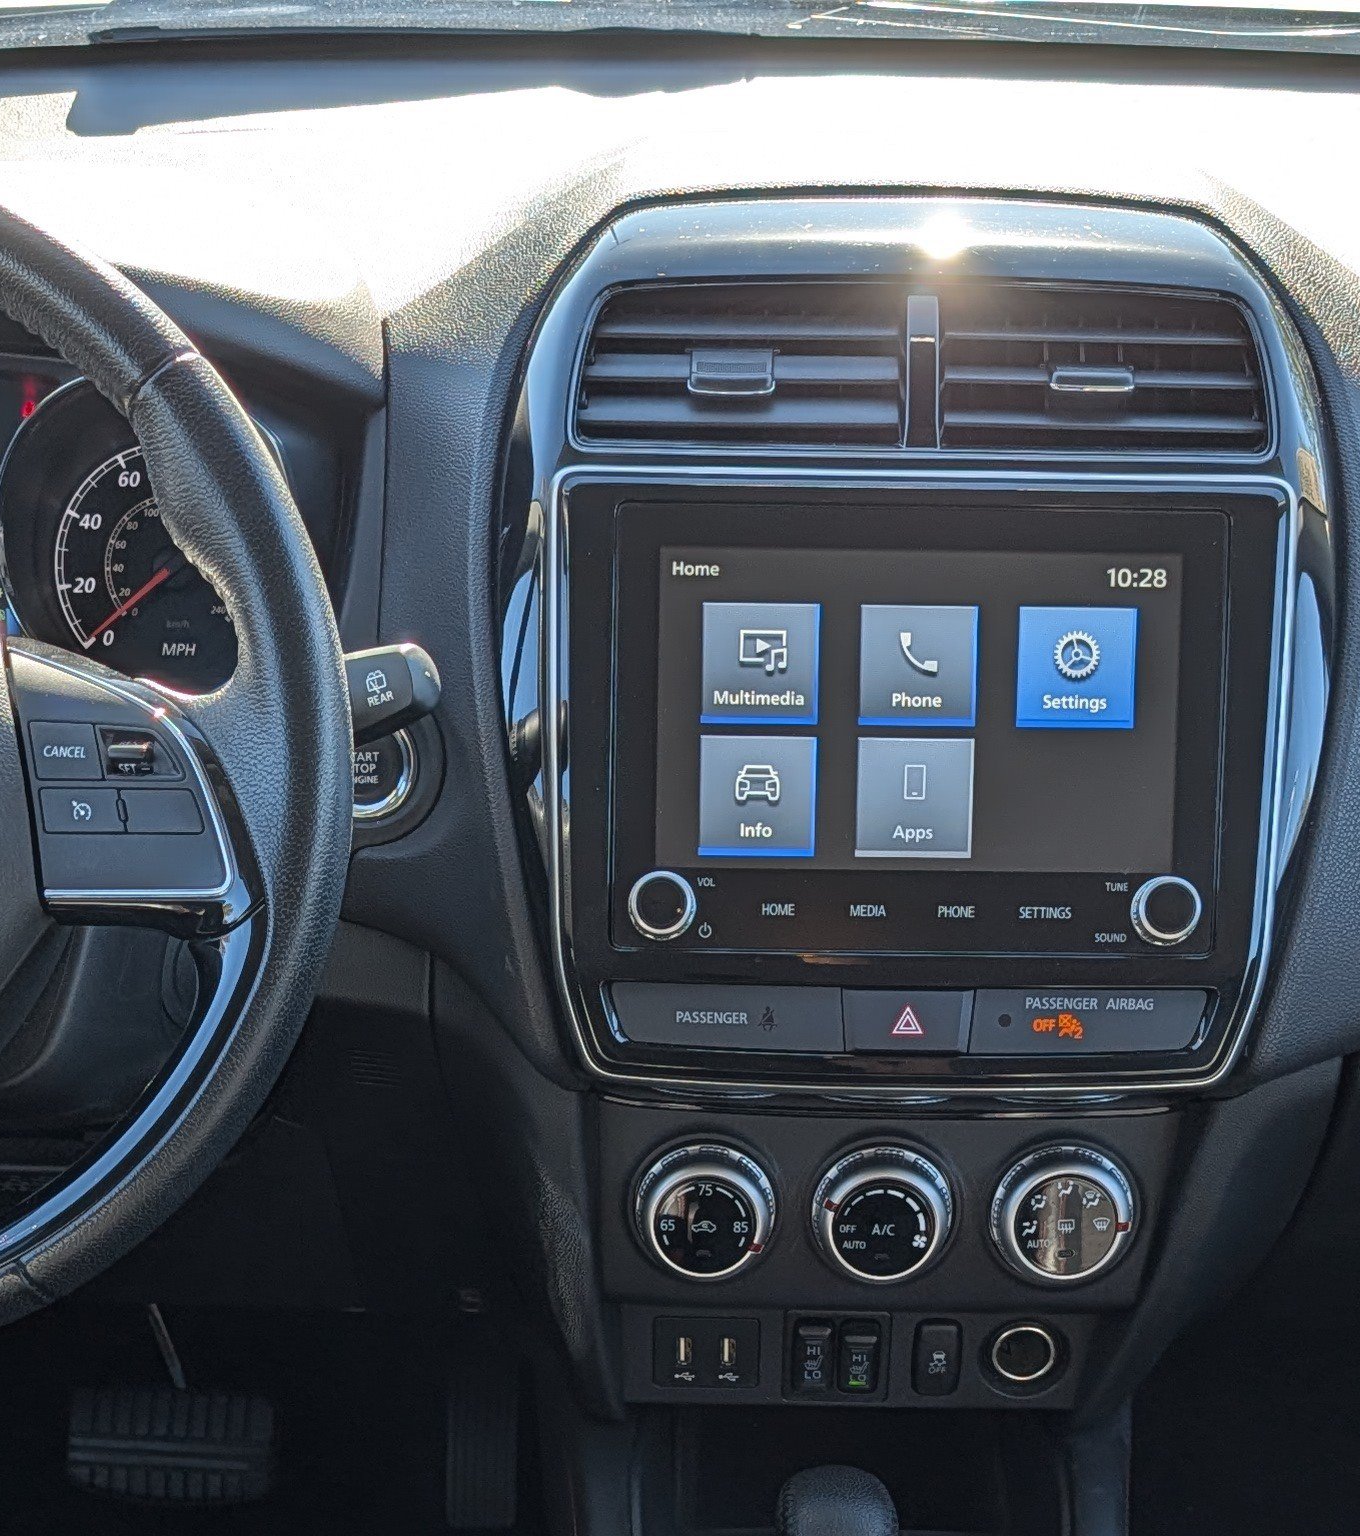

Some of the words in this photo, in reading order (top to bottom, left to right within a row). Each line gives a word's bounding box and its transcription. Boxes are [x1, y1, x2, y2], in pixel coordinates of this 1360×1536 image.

[118, 471, 141, 488] 60
[144, 508, 159, 517] 100
[79, 514, 102, 531] 40
[126, 521, 138, 530] 80
[115, 541, 127, 549] 60
[113, 564, 124, 573] 40
[672, 561, 720, 577] Home
[1106, 568, 1167, 588] 10:28
[73, 577, 96, 595] 20
[118, 588, 131, 597] 20
[103, 630, 114, 647] 0
[162, 643, 196, 656] MPH
[367, 690, 394, 707] REAR
[713, 690, 805, 706] Multimedia
[892, 692, 942, 708] Phone
[1043, 694, 1107, 713] Settings
[43, 745, 86, 759] CANCEL
[351, 751, 380, 762] TART
[353, 763, 377, 774] TOP
[739, 822, 773, 838] Info
[892, 825, 933, 843] Apps
[697, 877, 716, 887] VOL
[1105, 882, 1129, 892] TUNE
[761, 903, 796, 916] HOME
[849, 904, 887, 917] MEDIA
[937, 905, 976, 918] PHONE
[1018, 906, 1072, 919] SETTINGS
[1094, 933, 1127, 943] SOUND
[1025, 997, 1098, 1010] PASSENGER
[1106, 998, 1154, 1010] AIRBAG
[675, 1011, 748, 1026] PASSENGER
[1032, 1018, 1056, 1032] OFF
[698, 1184, 714, 1197] 75
[660, 1219, 675, 1232] 65
[733, 1220, 748, 1233] 85
[839, 1224, 857, 1233] OFF
[871, 1224, 895, 1237] A/C
[842, 1240, 866, 1250] AUTO
[1026, 1239, 1050, 1249] AUTO
[806, 1346, 821, 1356] HI
[852, 1354, 866, 1362] HI
[804, 1370, 822, 1380] LO
[928, 1366, 946, 1374] OFF
